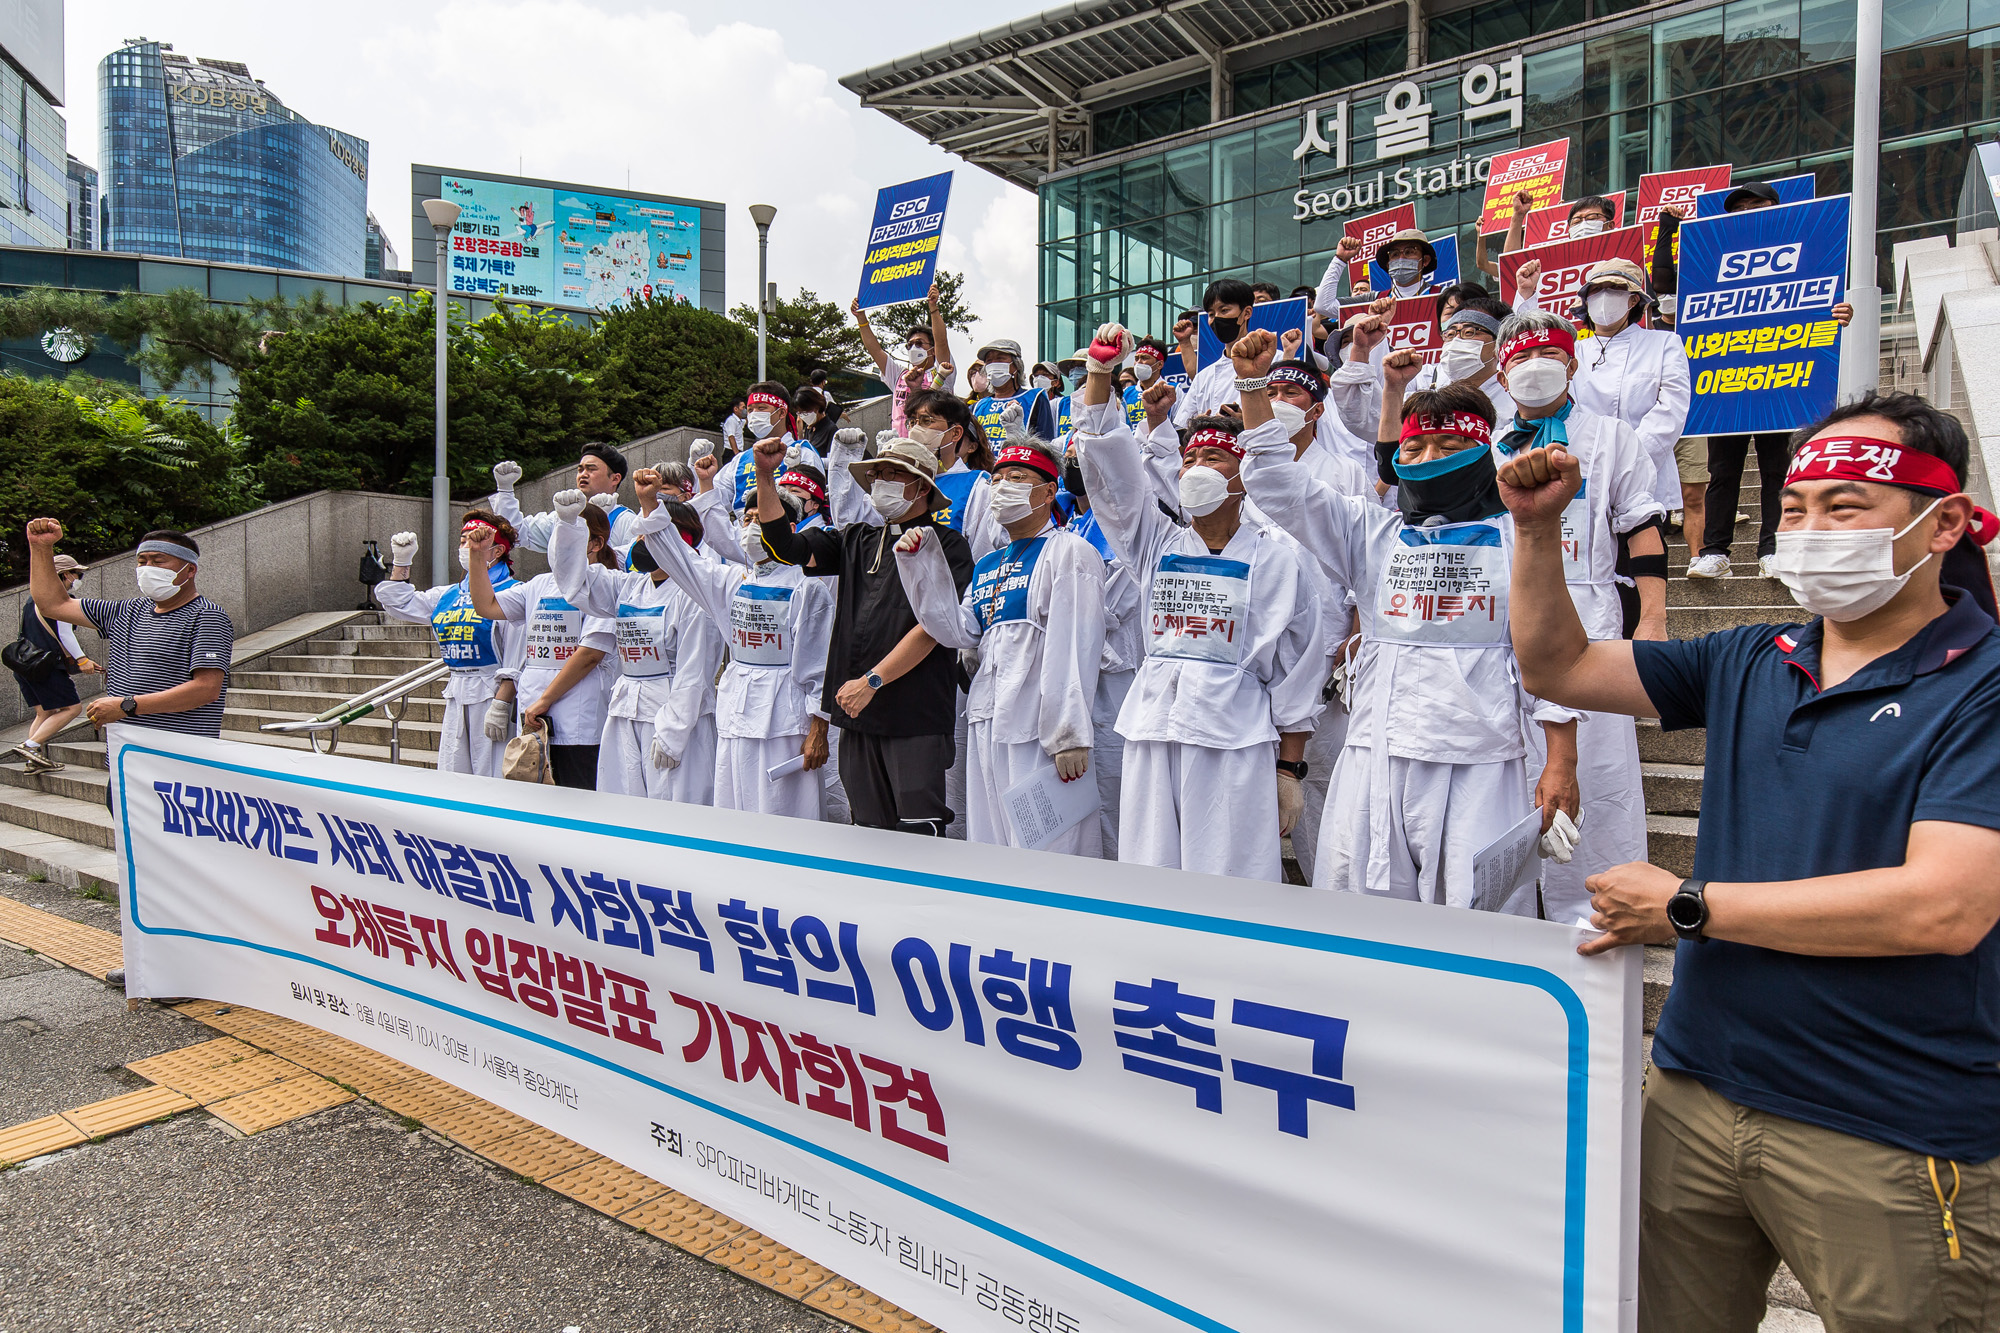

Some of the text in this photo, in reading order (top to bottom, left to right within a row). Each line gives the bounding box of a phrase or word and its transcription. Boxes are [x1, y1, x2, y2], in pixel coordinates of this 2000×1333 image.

[173, 84, 268, 115] KDB생명
[1293, 54, 1522, 168] 서울역
[329, 135, 366, 181] KDB생명
[1511, 155, 1545, 169] SPC
[1293, 153, 1491, 220] Seoul Statio
[1491, 161, 1563, 186] 파리바게뜨
[893, 198, 926, 217] SPC
[454, 221, 500, 237] 비행기 타고
[872, 215, 940, 243] 파리바게뜨
[1365, 223, 1396, 243] SPC
[453, 236, 540, 258] 포항경주공항으로
[865, 236, 939, 265] 사회적합의를
[453, 256, 515, 276] 축제 가득한
[870, 259, 926, 284] 이행하라!
[1723, 246, 1798, 279] SPC
[1686, 279, 1833, 321] 파리바게뜨
[1518, 328, 1550, 346] 투쟁
[1685, 320, 1839, 359] 사회적합의를
[1695, 361, 1815, 395] 이행하라!
[1816, 440, 1902, 480] 투쟁
[1393, 552, 1465, 565] SPC파리바게뜨
[1433, 565, 1483, 579] 엄벌촉구
[1182, 590, 1228, 604] 엄벌촉구
[1384, 593, 1495, 621] 오체투지
[1152, 614, 1235, 643] 오체투지
[537, 646, 550, 659] 32
[153, 780, 1356, 1140] 파리바게뜨 사태 해결과 사회적 합의 이행 촉구
[309, 884, 950, 1164] 오체투지 입장발표 기자회견
[290, 981, 313, 1004] 일시
[314, 989, 327, 1009] 및
[326, 993, 350, 1017] 장소
[355, 1002, 375, 1027] 8월
[377, 1011, 413, 1042] 4일(목)
[415, 1024, 440, 1052] 10시
[442, 1034, 470, 1065] 30분
[482, 1051, 520, 1086] 서울역
[522, 1067, 579, 1111] 중앙계단
[650, 1120, 683, 1158] 주최
[695, 1140, 821, 1222] SPC파리바게뜨
[827, 1200, 891, 1257] 노동자
[898, 1235, 969, 1295] 힘내라
